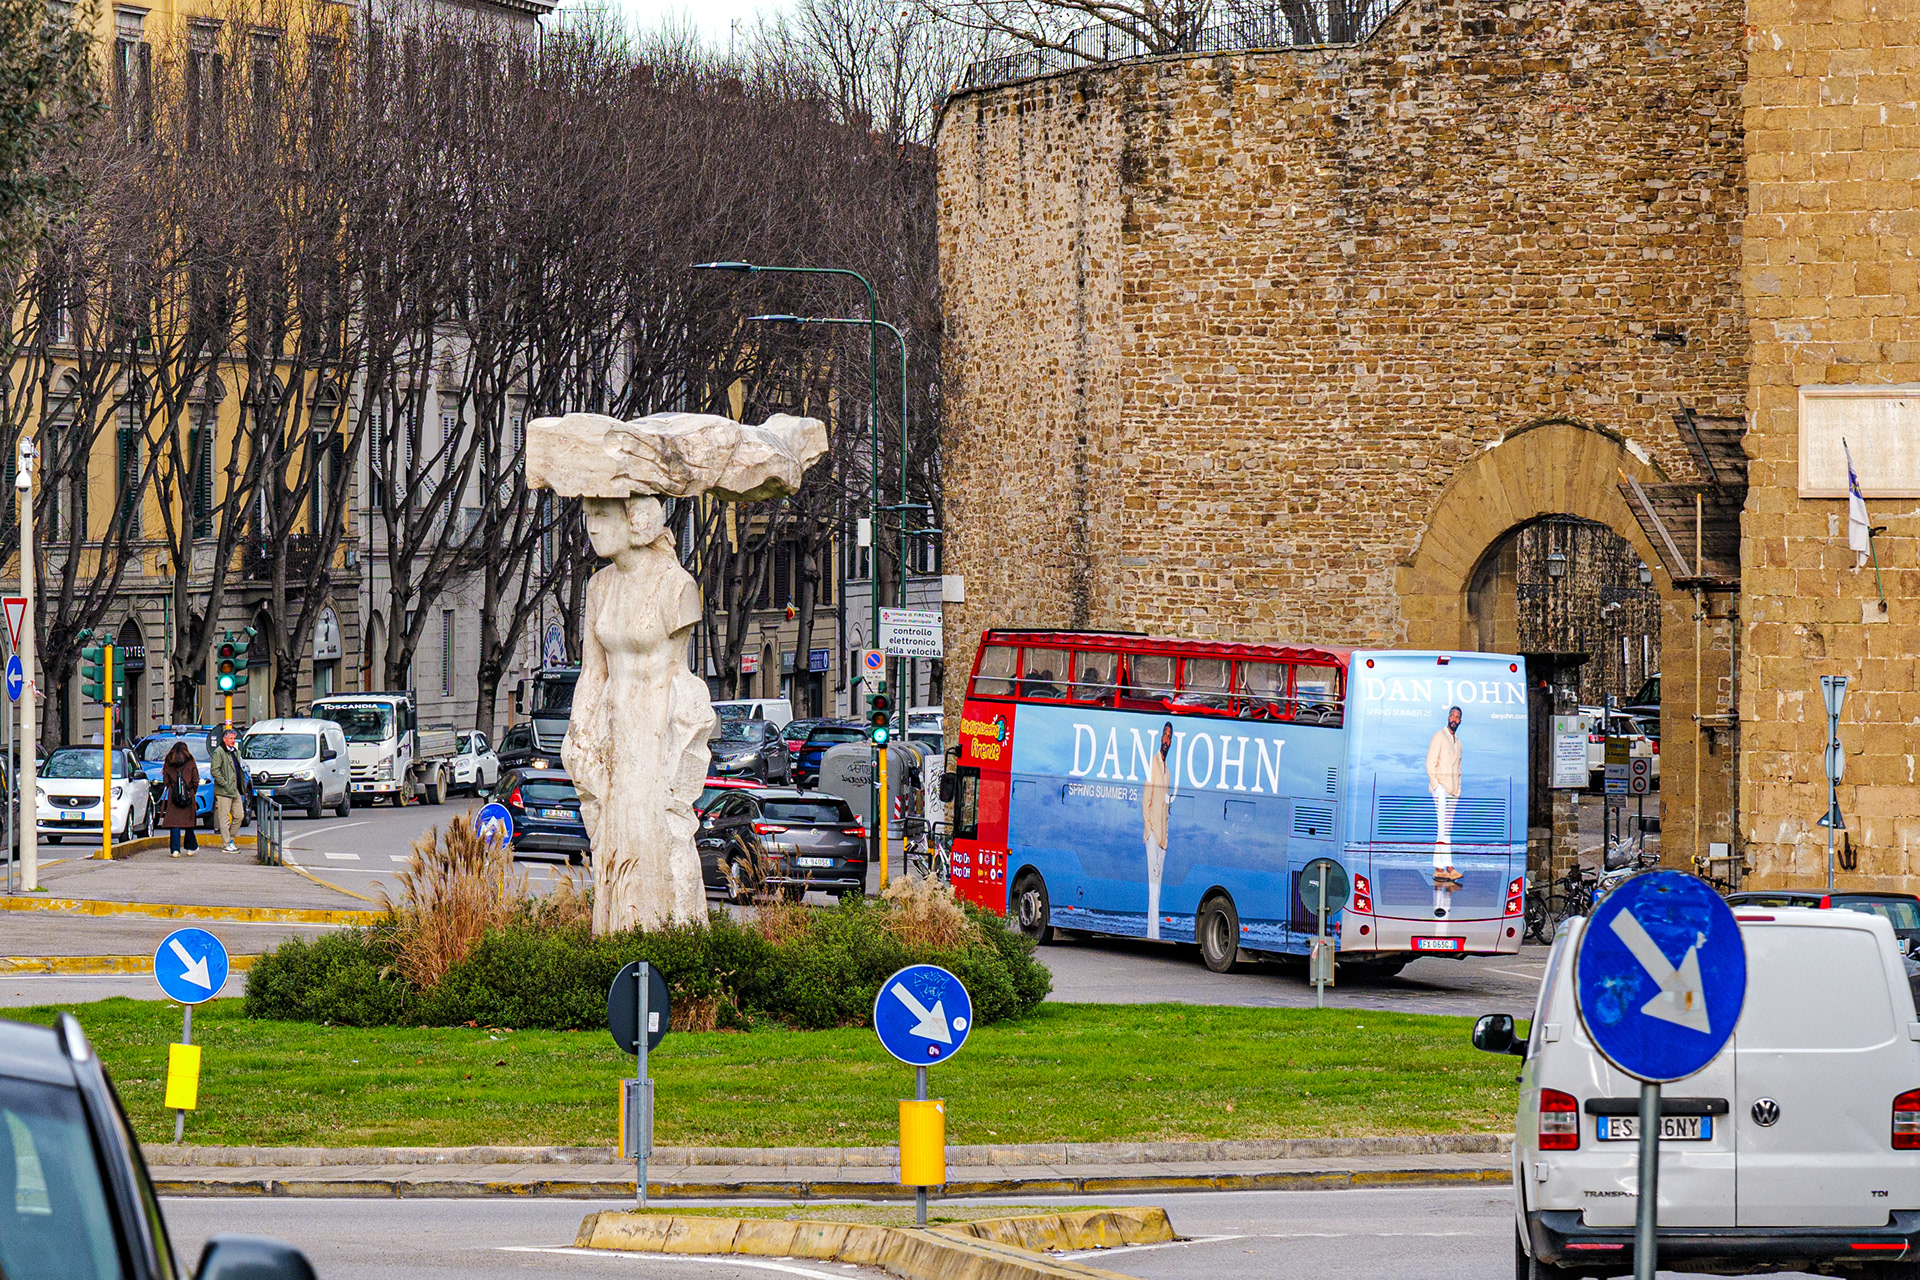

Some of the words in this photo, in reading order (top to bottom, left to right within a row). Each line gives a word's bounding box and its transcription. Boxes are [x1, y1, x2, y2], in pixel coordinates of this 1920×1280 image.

[893, 628, 933, 637] controllo
[889, 637, 936, 646] elettronico
[1365, 678, 1433, 702] DAN
[1442, 680, 1527, 710] JOHN
[1366, 708, 1391, 716] SPRING
[1392, 709, 1422, 717] SUMMER
[1490, 712, 1528, 720] danjohn.com
[971, 737, 1001, 761] Firenze
[1069, 723, 1159, 783] DAN
[1164, 732, 1286, 804] JOHN
[1068, 782, 1095, 798] SPRING
[1095, 786, 1128, 800] SUMMER
[1129, 788, 1138, 801] 25
[1611, 1119, 1633, 1136] ES
